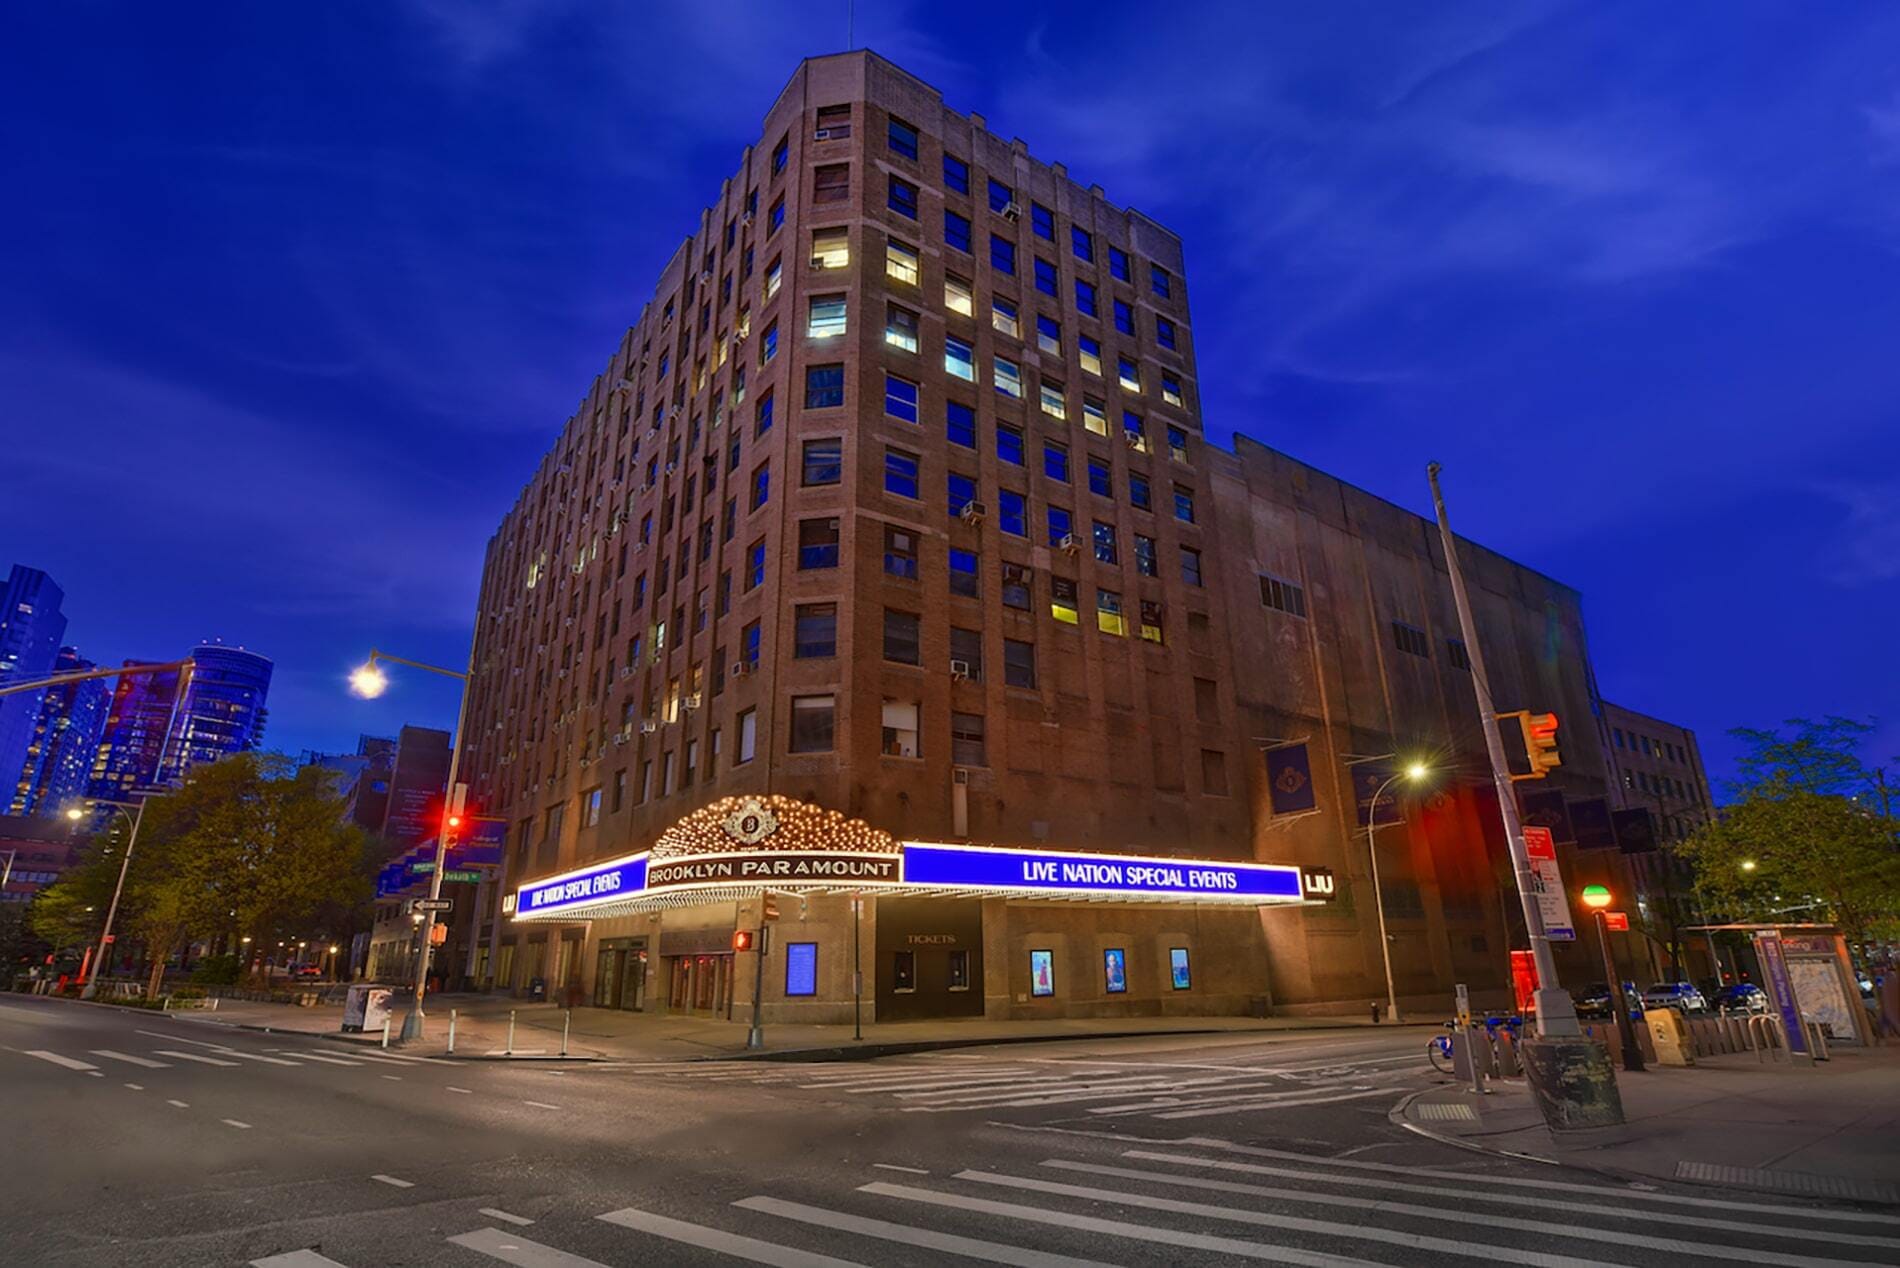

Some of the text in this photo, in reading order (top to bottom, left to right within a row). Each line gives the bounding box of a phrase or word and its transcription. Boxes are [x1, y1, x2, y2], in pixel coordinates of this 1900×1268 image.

[650, 860, 893, 883] BROOKLYN PARAMOUNT
[1023, 861, 1238, 890] LIVE NATION SPECIAL EVENTS
[565, 878, 592, 900] SPECIAL
[593, 871, 622, 894] EVENTS
[1304, 874, 1334, 894] LIU
[907, 934, 957, 945] TICKETS
